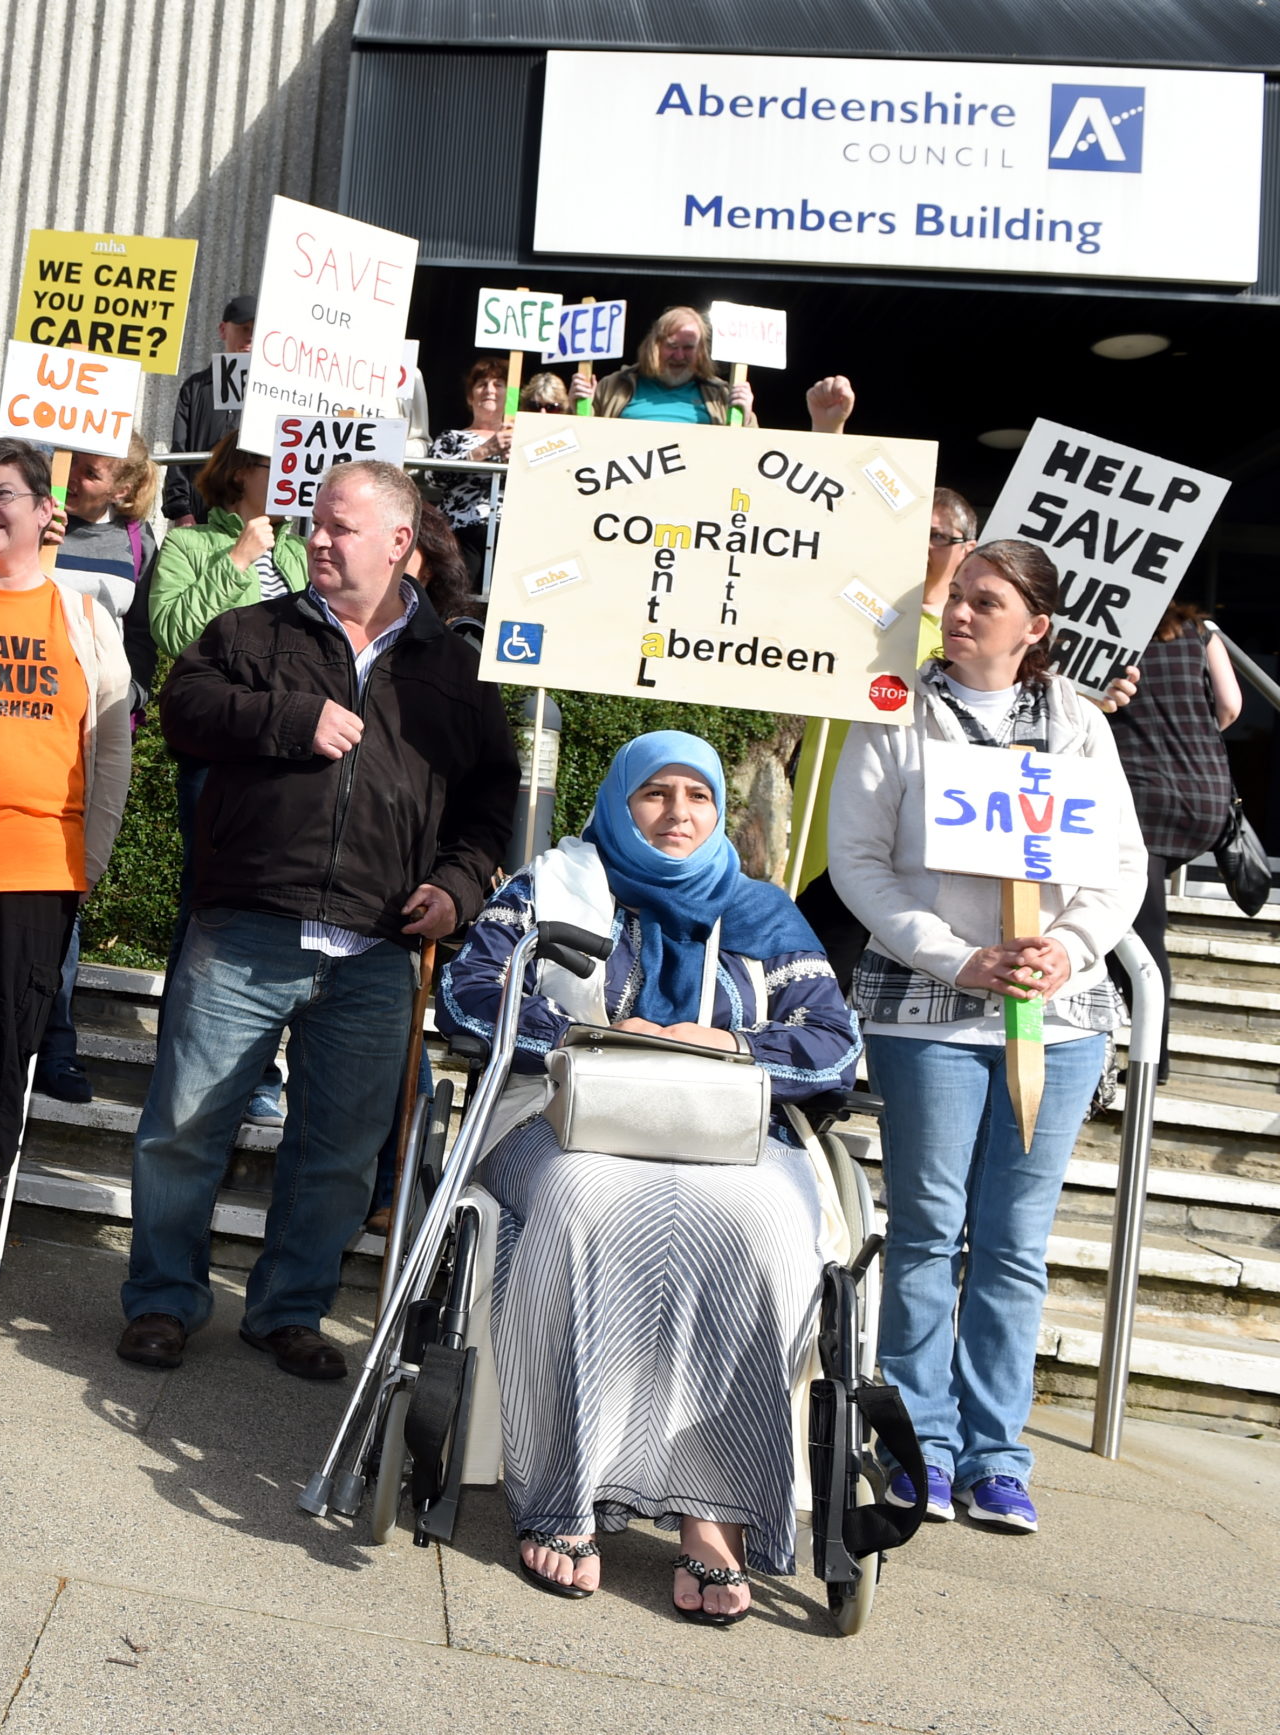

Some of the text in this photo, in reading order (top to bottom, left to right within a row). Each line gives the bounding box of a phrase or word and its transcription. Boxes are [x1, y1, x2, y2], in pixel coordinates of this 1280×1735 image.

[655, 82, 1016, 127] Aberdeenshire
[843, 142, 1014, 168] COUNCIL
[682, 194, 1103, 255] Members Building
[39, 260, 177, 292] WE CARE
[294, 232, 403, 305] SAVE
[33, 290, 175, 320] YOU DON'T
[311, 304, 351, 329] OUR
[484, 297, 554, 342] SAFE
[30, 316, 167, 358] CARE?
[37, 353, 108, 395] WE
[262, 331, 387, 398] COMRAICH
[8, 394, 132, 439] COUNT
[252, 381, 313, 408] mental
[280, 419, 377, 451] SAVE
[575, 443, 686, 496] SAVE
[757, 450, 845, 512] OUR
[1042, 440, 1201, 513] HELP
[1017, 491, 1184, 584] SAVE
[1055, 570, 1131, 638] UR
[1049, 628, 1141, 692] AICH
[870, 686, 907, 700] STOP
[935, 789, 1096, 834] SAVE
[1018, 752, 1055, 880] LIVES
